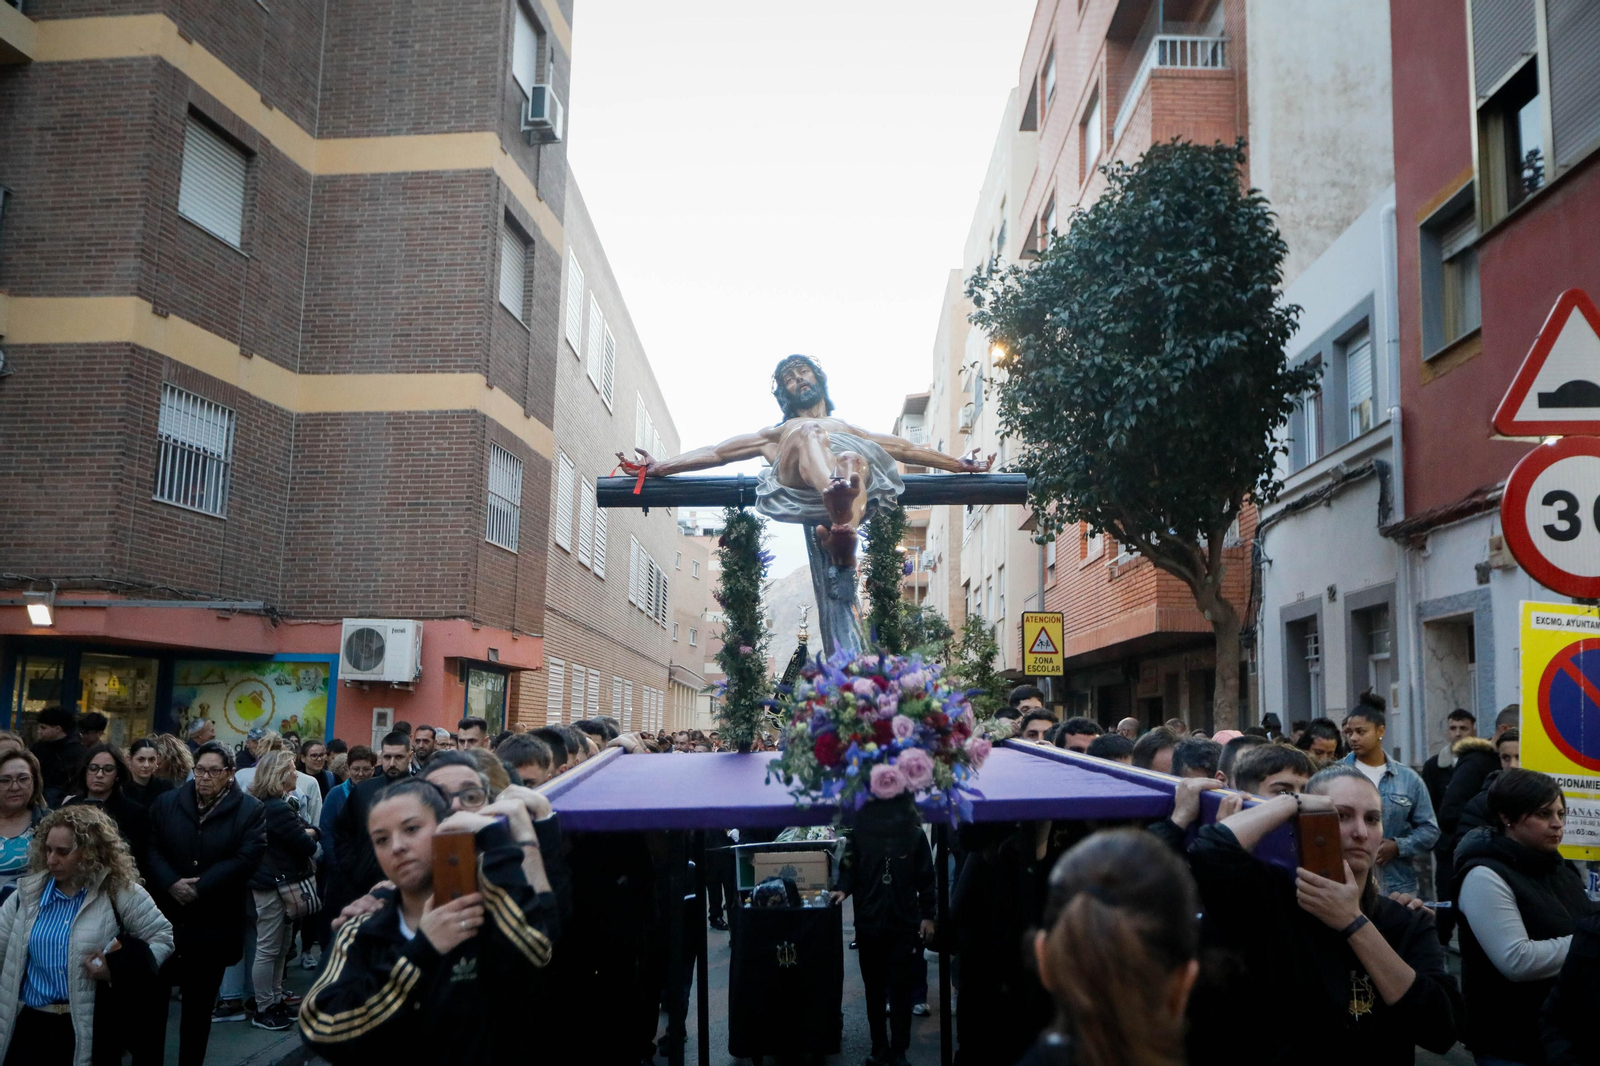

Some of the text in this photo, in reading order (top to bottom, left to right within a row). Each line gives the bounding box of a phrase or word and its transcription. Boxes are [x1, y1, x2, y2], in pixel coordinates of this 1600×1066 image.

[1541, 489, 1600, 542] 3
[1025, 615, 1061, 623] ATENCIÓN
[1535, 616, 1565, 627] EXCMO.
